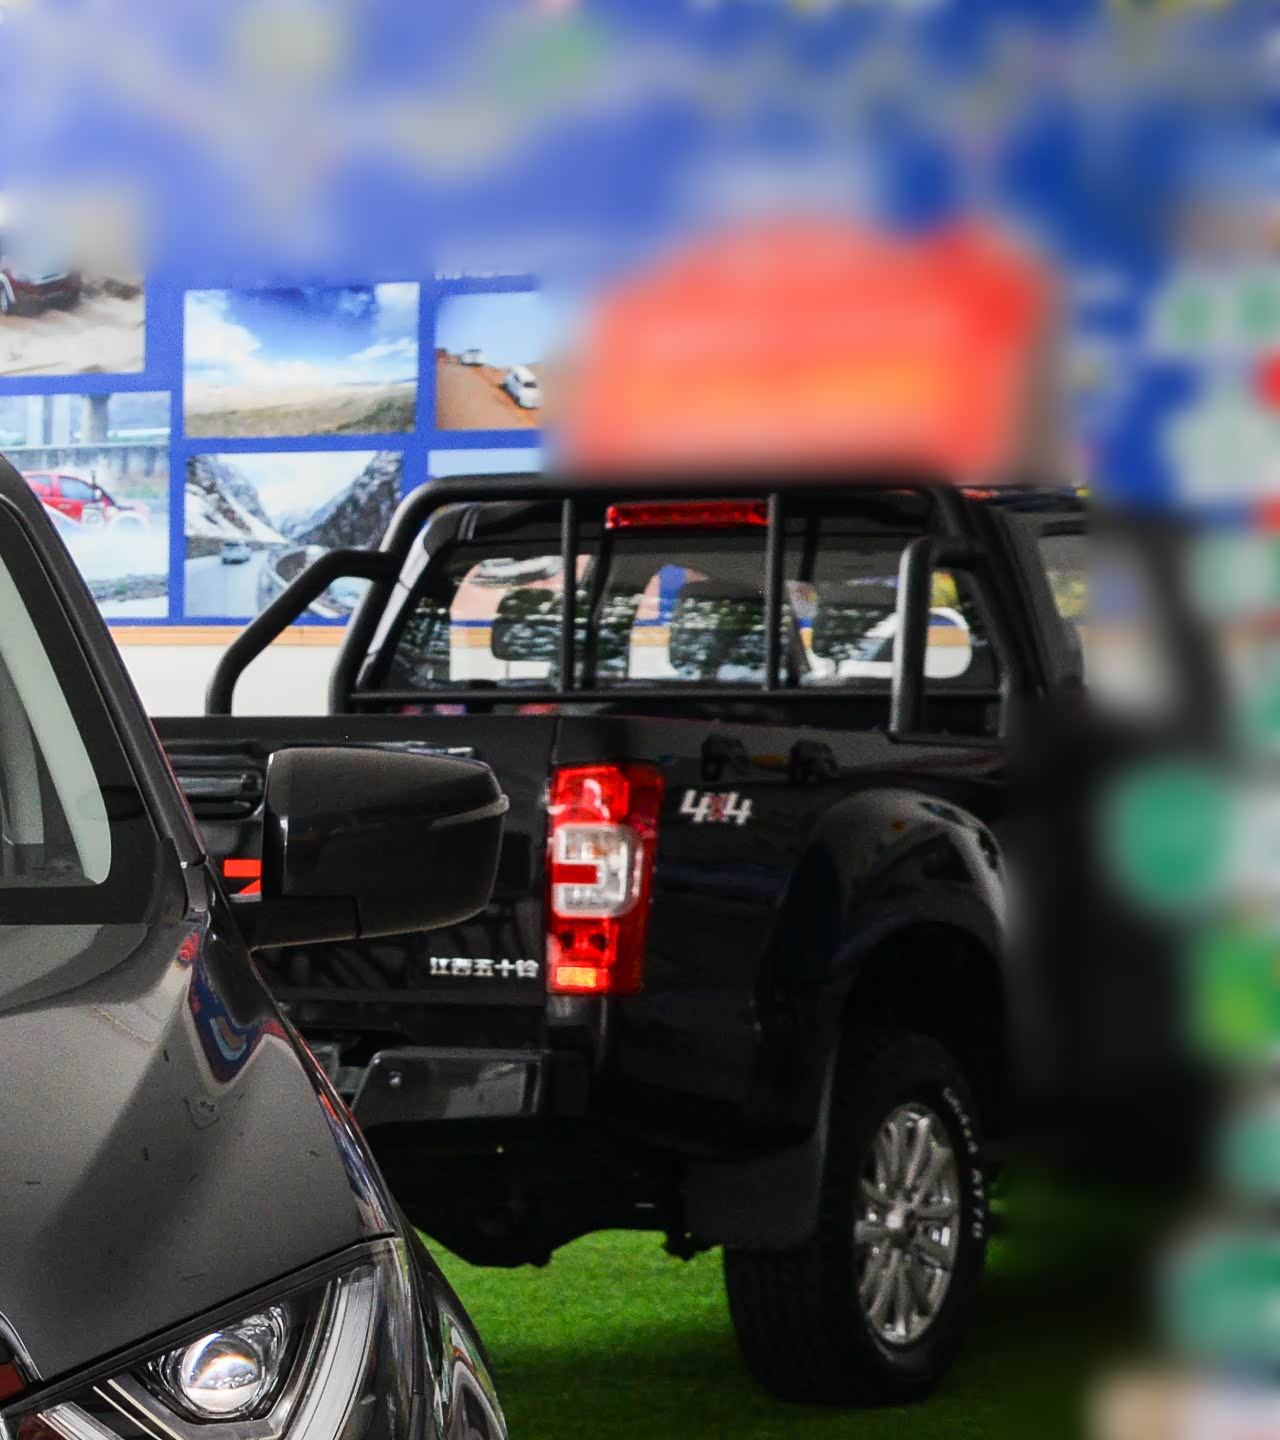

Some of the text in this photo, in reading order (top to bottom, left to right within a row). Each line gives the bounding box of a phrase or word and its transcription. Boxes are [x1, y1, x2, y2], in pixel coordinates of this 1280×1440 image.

[429, 956, 540, 979] 江西五十铃
